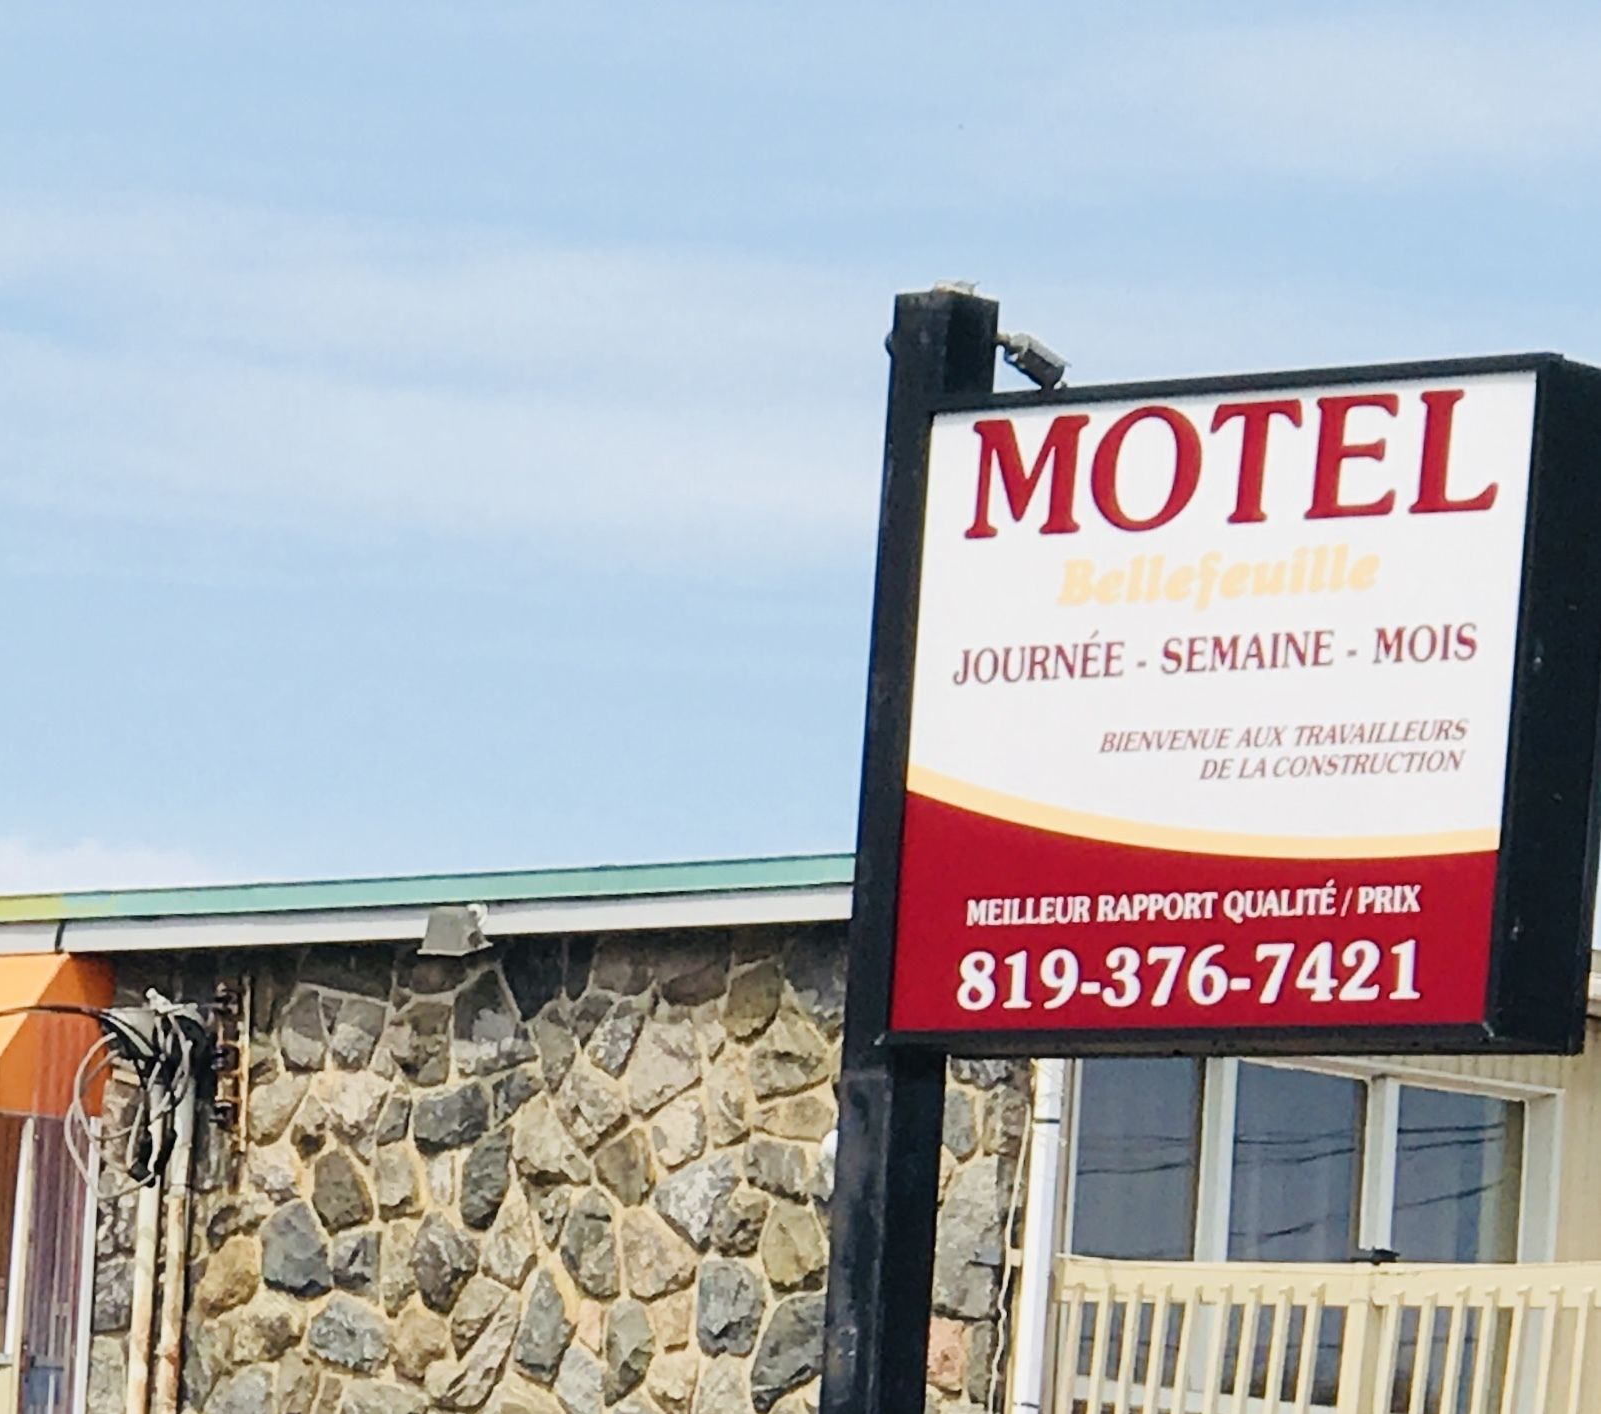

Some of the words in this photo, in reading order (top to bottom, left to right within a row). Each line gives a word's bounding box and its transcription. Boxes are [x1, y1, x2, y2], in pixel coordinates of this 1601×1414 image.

[964, 389, 1499, 539] MOTEL
[1057, 543, 1382, 611] Bellefeuille
[952, 629, 1126, 686] JOURNÉE
[1161, 631, 1333, 674] SEMAINE
[1374, 623, 1477, 663] MOIS
[1099, 728, 1232, 753] BIENVENUE
[1236, 725, 1287, 749] AUX
[1293, 718, 1470, 747] TRAVAILLEURS
[1198, 757, 1235, 780] DE
[1237, 756, 1267, 779] LA
[1271, 749, 1466, 778] CONSTRUCTION
[967, 896, 1090, 925] MEILLEUR
[1097, 892, 1218, 921] RAPPORT
[1224, 880, 1336, 923] QUALITÉ
[1358, 885, 1420, 913] PRIX
[957, 940, 1420, 1010] 819-376-7421
